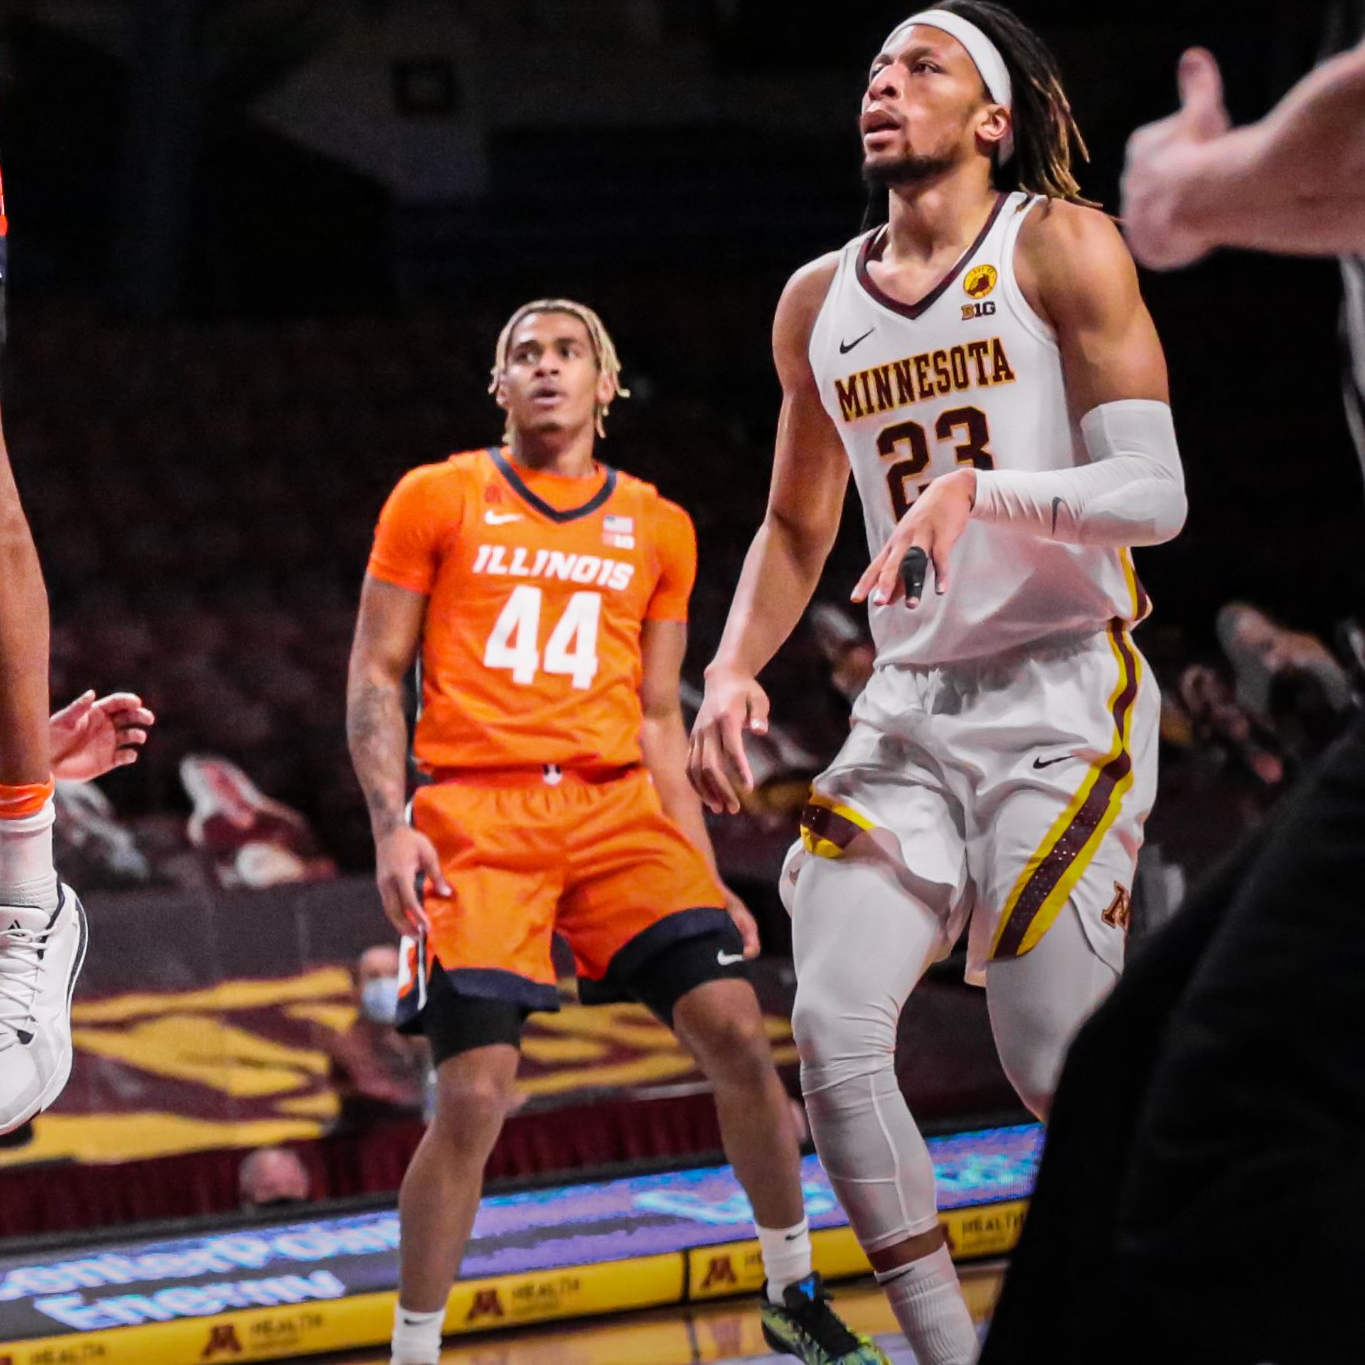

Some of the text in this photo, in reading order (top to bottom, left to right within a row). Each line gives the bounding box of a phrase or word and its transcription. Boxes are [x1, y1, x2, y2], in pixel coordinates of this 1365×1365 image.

[835, 337, 1017, 422] MINNESOTA
[472, 545, 635, 591] ILLINOIS
[483, 584, 601, 691] 44
